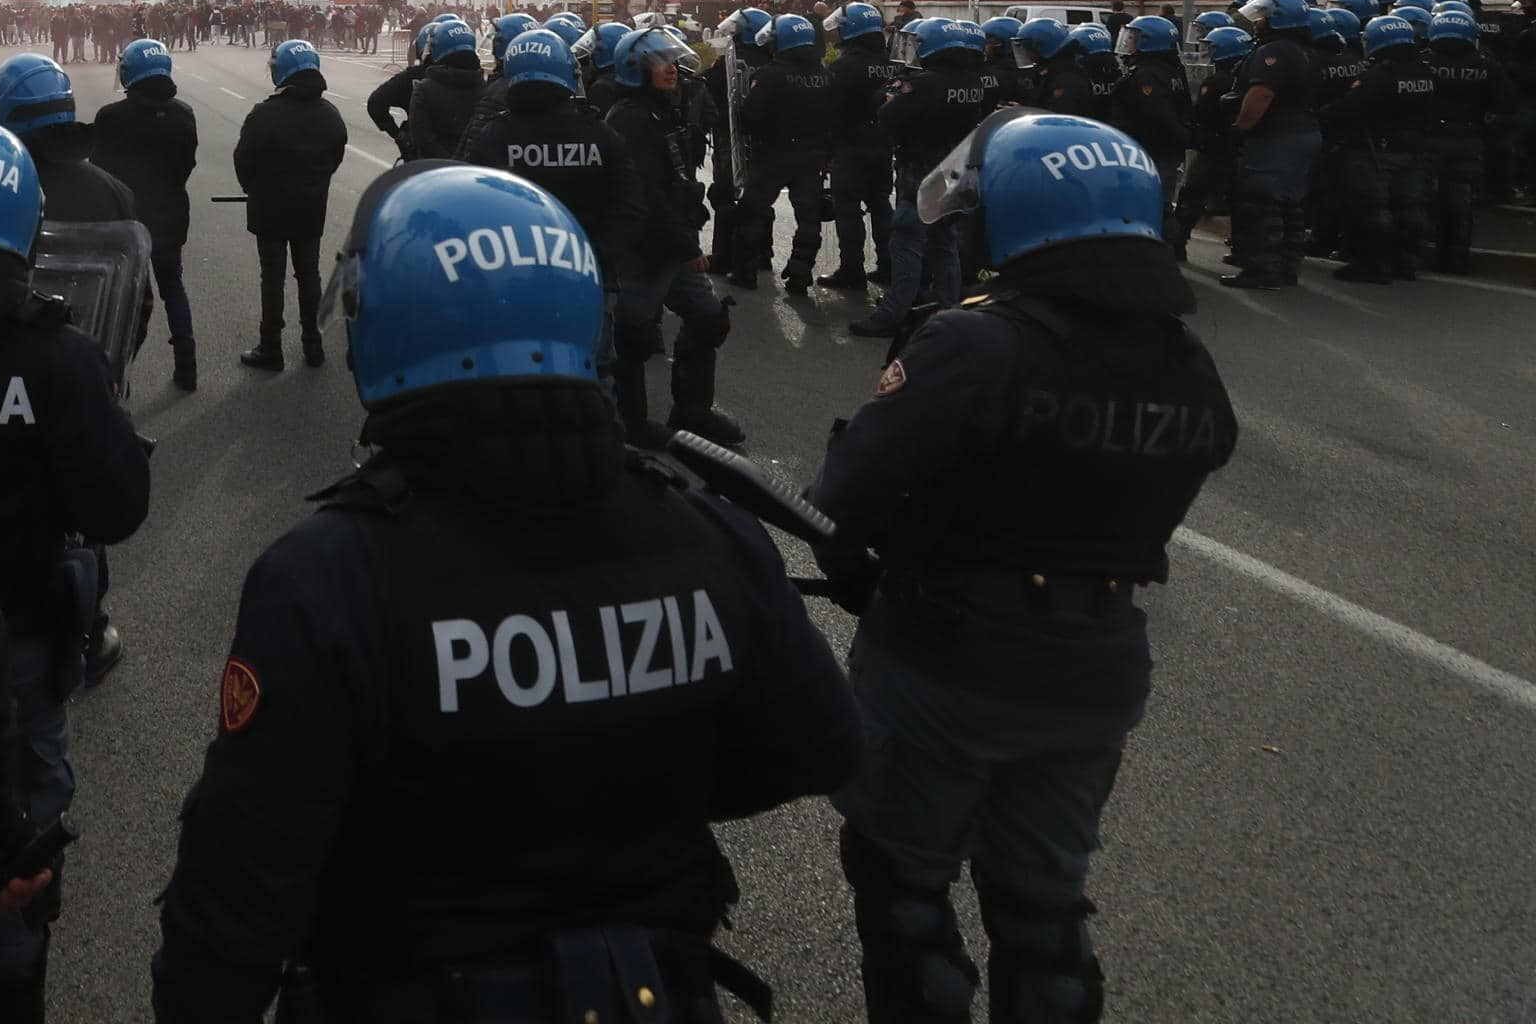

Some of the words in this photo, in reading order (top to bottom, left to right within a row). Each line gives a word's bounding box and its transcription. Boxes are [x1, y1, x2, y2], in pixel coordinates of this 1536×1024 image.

[448, 26, 472, 38] POLI
[792, 22, 814, 33] POLI
[505, 42, 551, 62] POLIZIA
[1397, 79, 1435, 94] POLIZIA
[508, 143, 602, 167] POLIZIA
[433, 226, 600, 284] POLIZIA
[1021, 388, 1217, 458] POLIZIA
[432, 589, 734, 713] POLIZIA
